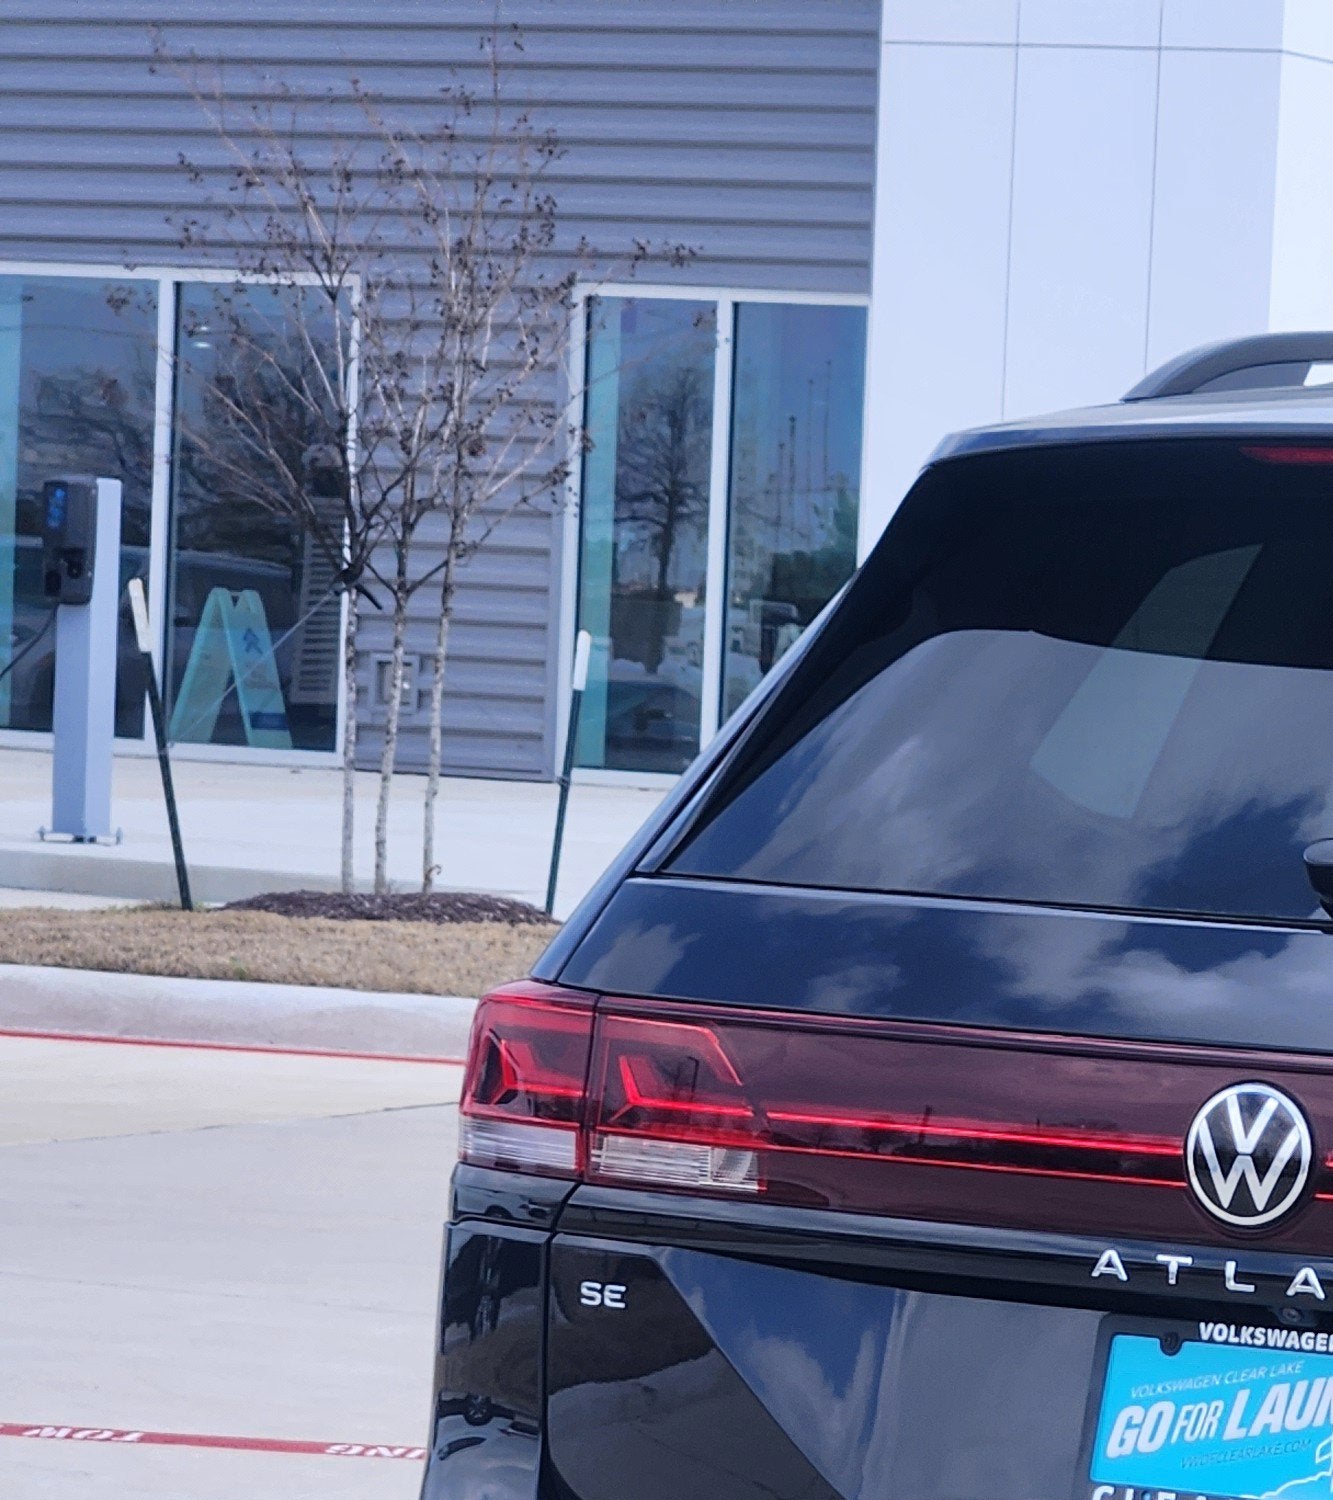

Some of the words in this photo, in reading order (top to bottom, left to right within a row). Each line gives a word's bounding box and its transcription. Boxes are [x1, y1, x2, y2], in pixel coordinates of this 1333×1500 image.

[580, 1281, 626, 1309] SE
[1131, 1375, 1222, 1398] VOLKSWAGEN
[1224, 1367, 1267, 1385] CLEAR
[1270, 1361, 1304, 1378] LAKE
[1107, 1402, 1176, 1458] GO
[1171, 1401, 1222, 1443] FOR
